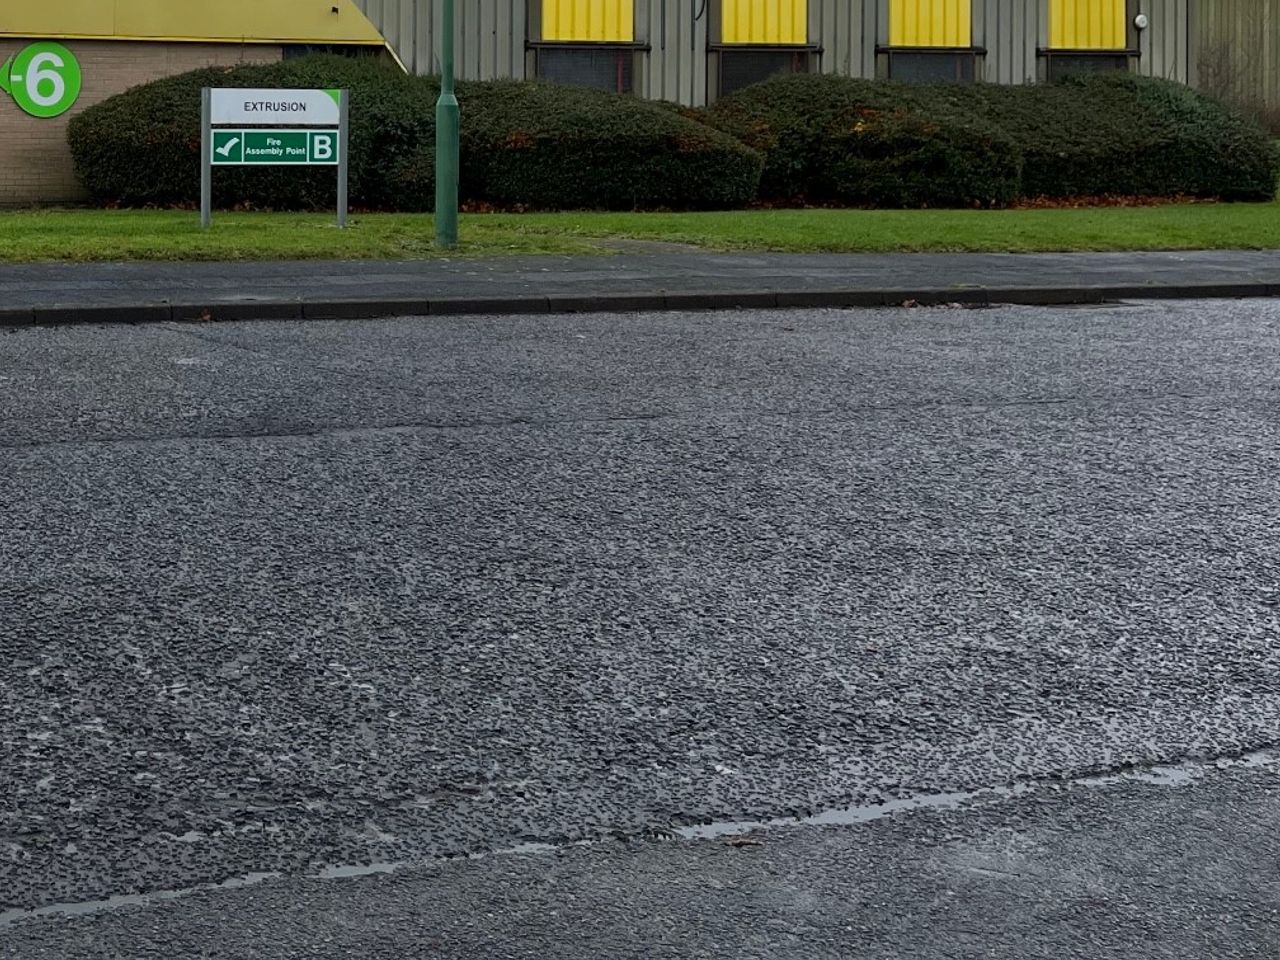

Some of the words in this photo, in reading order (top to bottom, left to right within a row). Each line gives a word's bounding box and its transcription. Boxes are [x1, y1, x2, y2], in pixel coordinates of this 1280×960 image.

[244, 101, 307, 112] EXTRUSION
[266, 138, 282, 146] Fire
[313, 135, 333, 159] B
[245, 147, 283, 156] Assembly
[286, 147, 306, 155] Point
